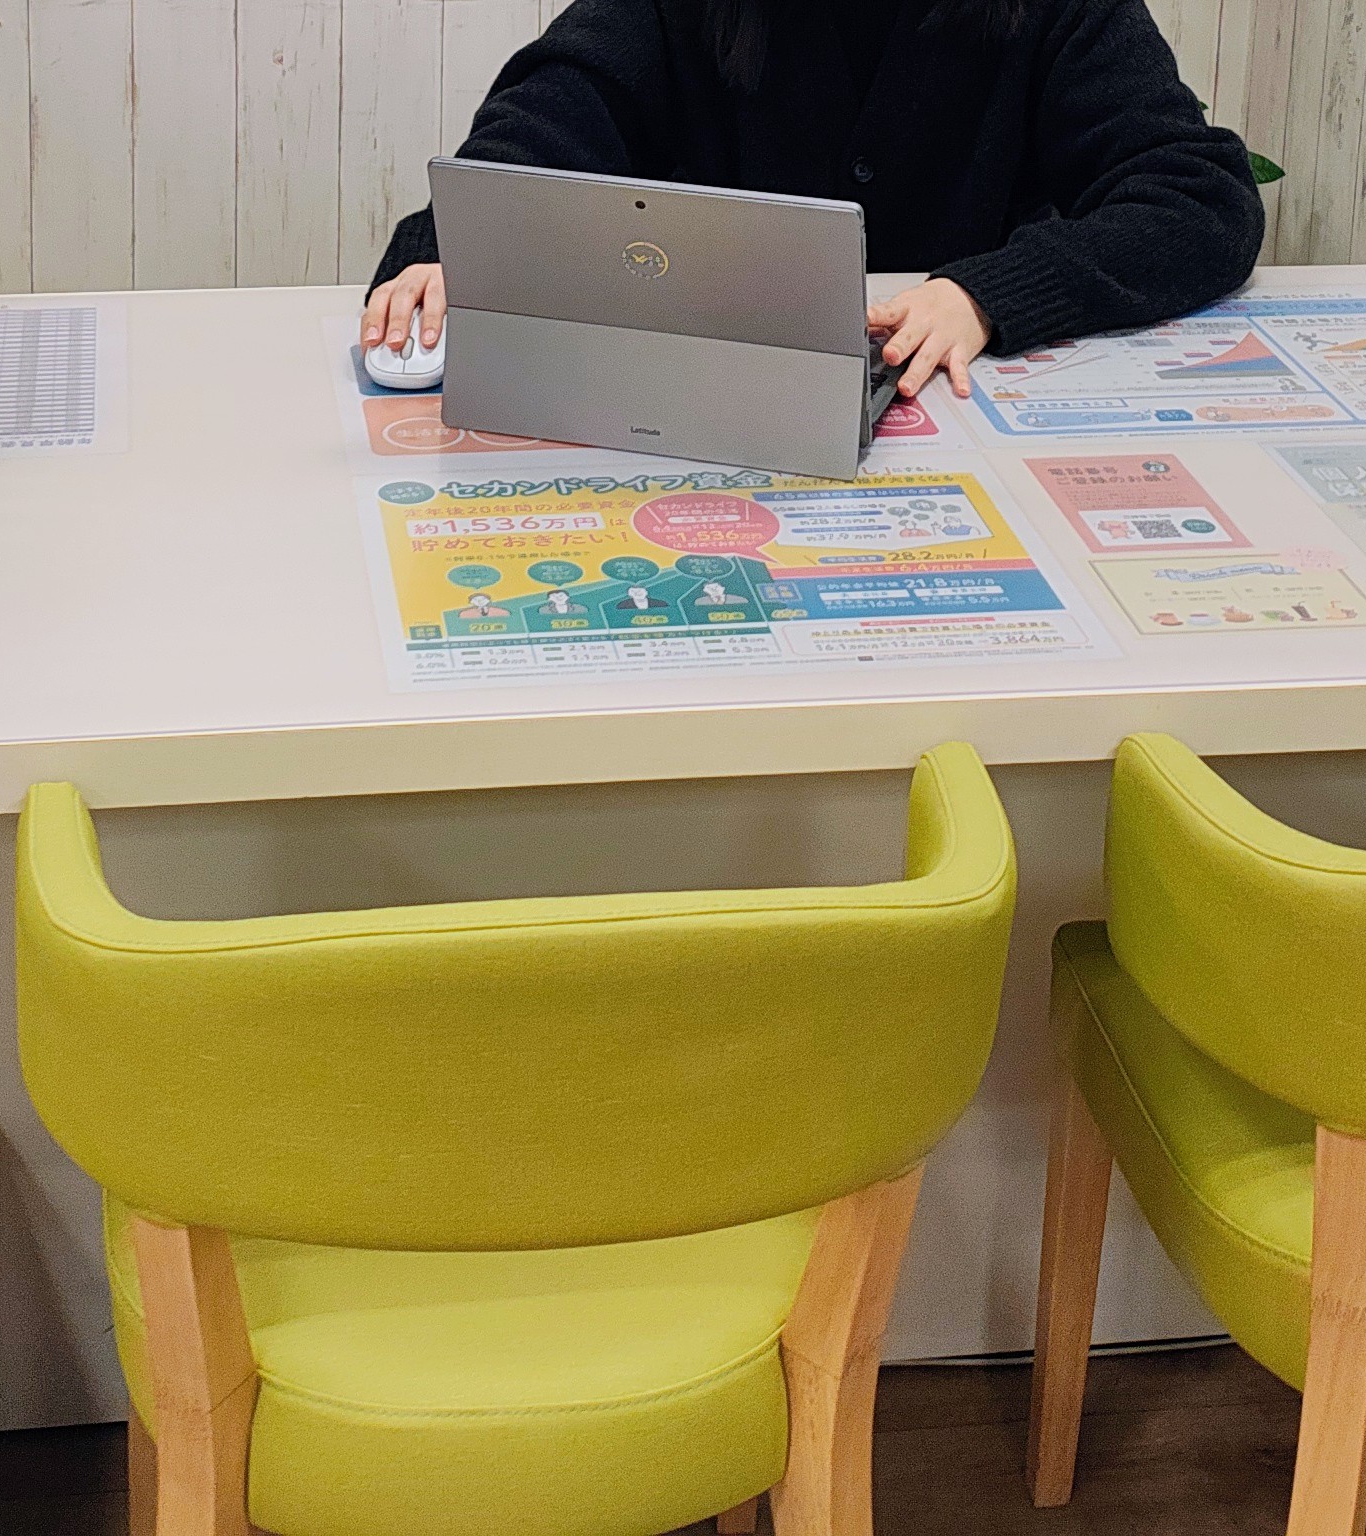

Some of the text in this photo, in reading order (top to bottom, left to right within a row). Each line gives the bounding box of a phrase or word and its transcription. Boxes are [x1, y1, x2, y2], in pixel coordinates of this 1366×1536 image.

[439, 470, 774, 501] セカンドライフ資金
[414, 516, 627, 536] 約1,536万円 は
[412, 530, 629, 553] 貯めておきたい!
